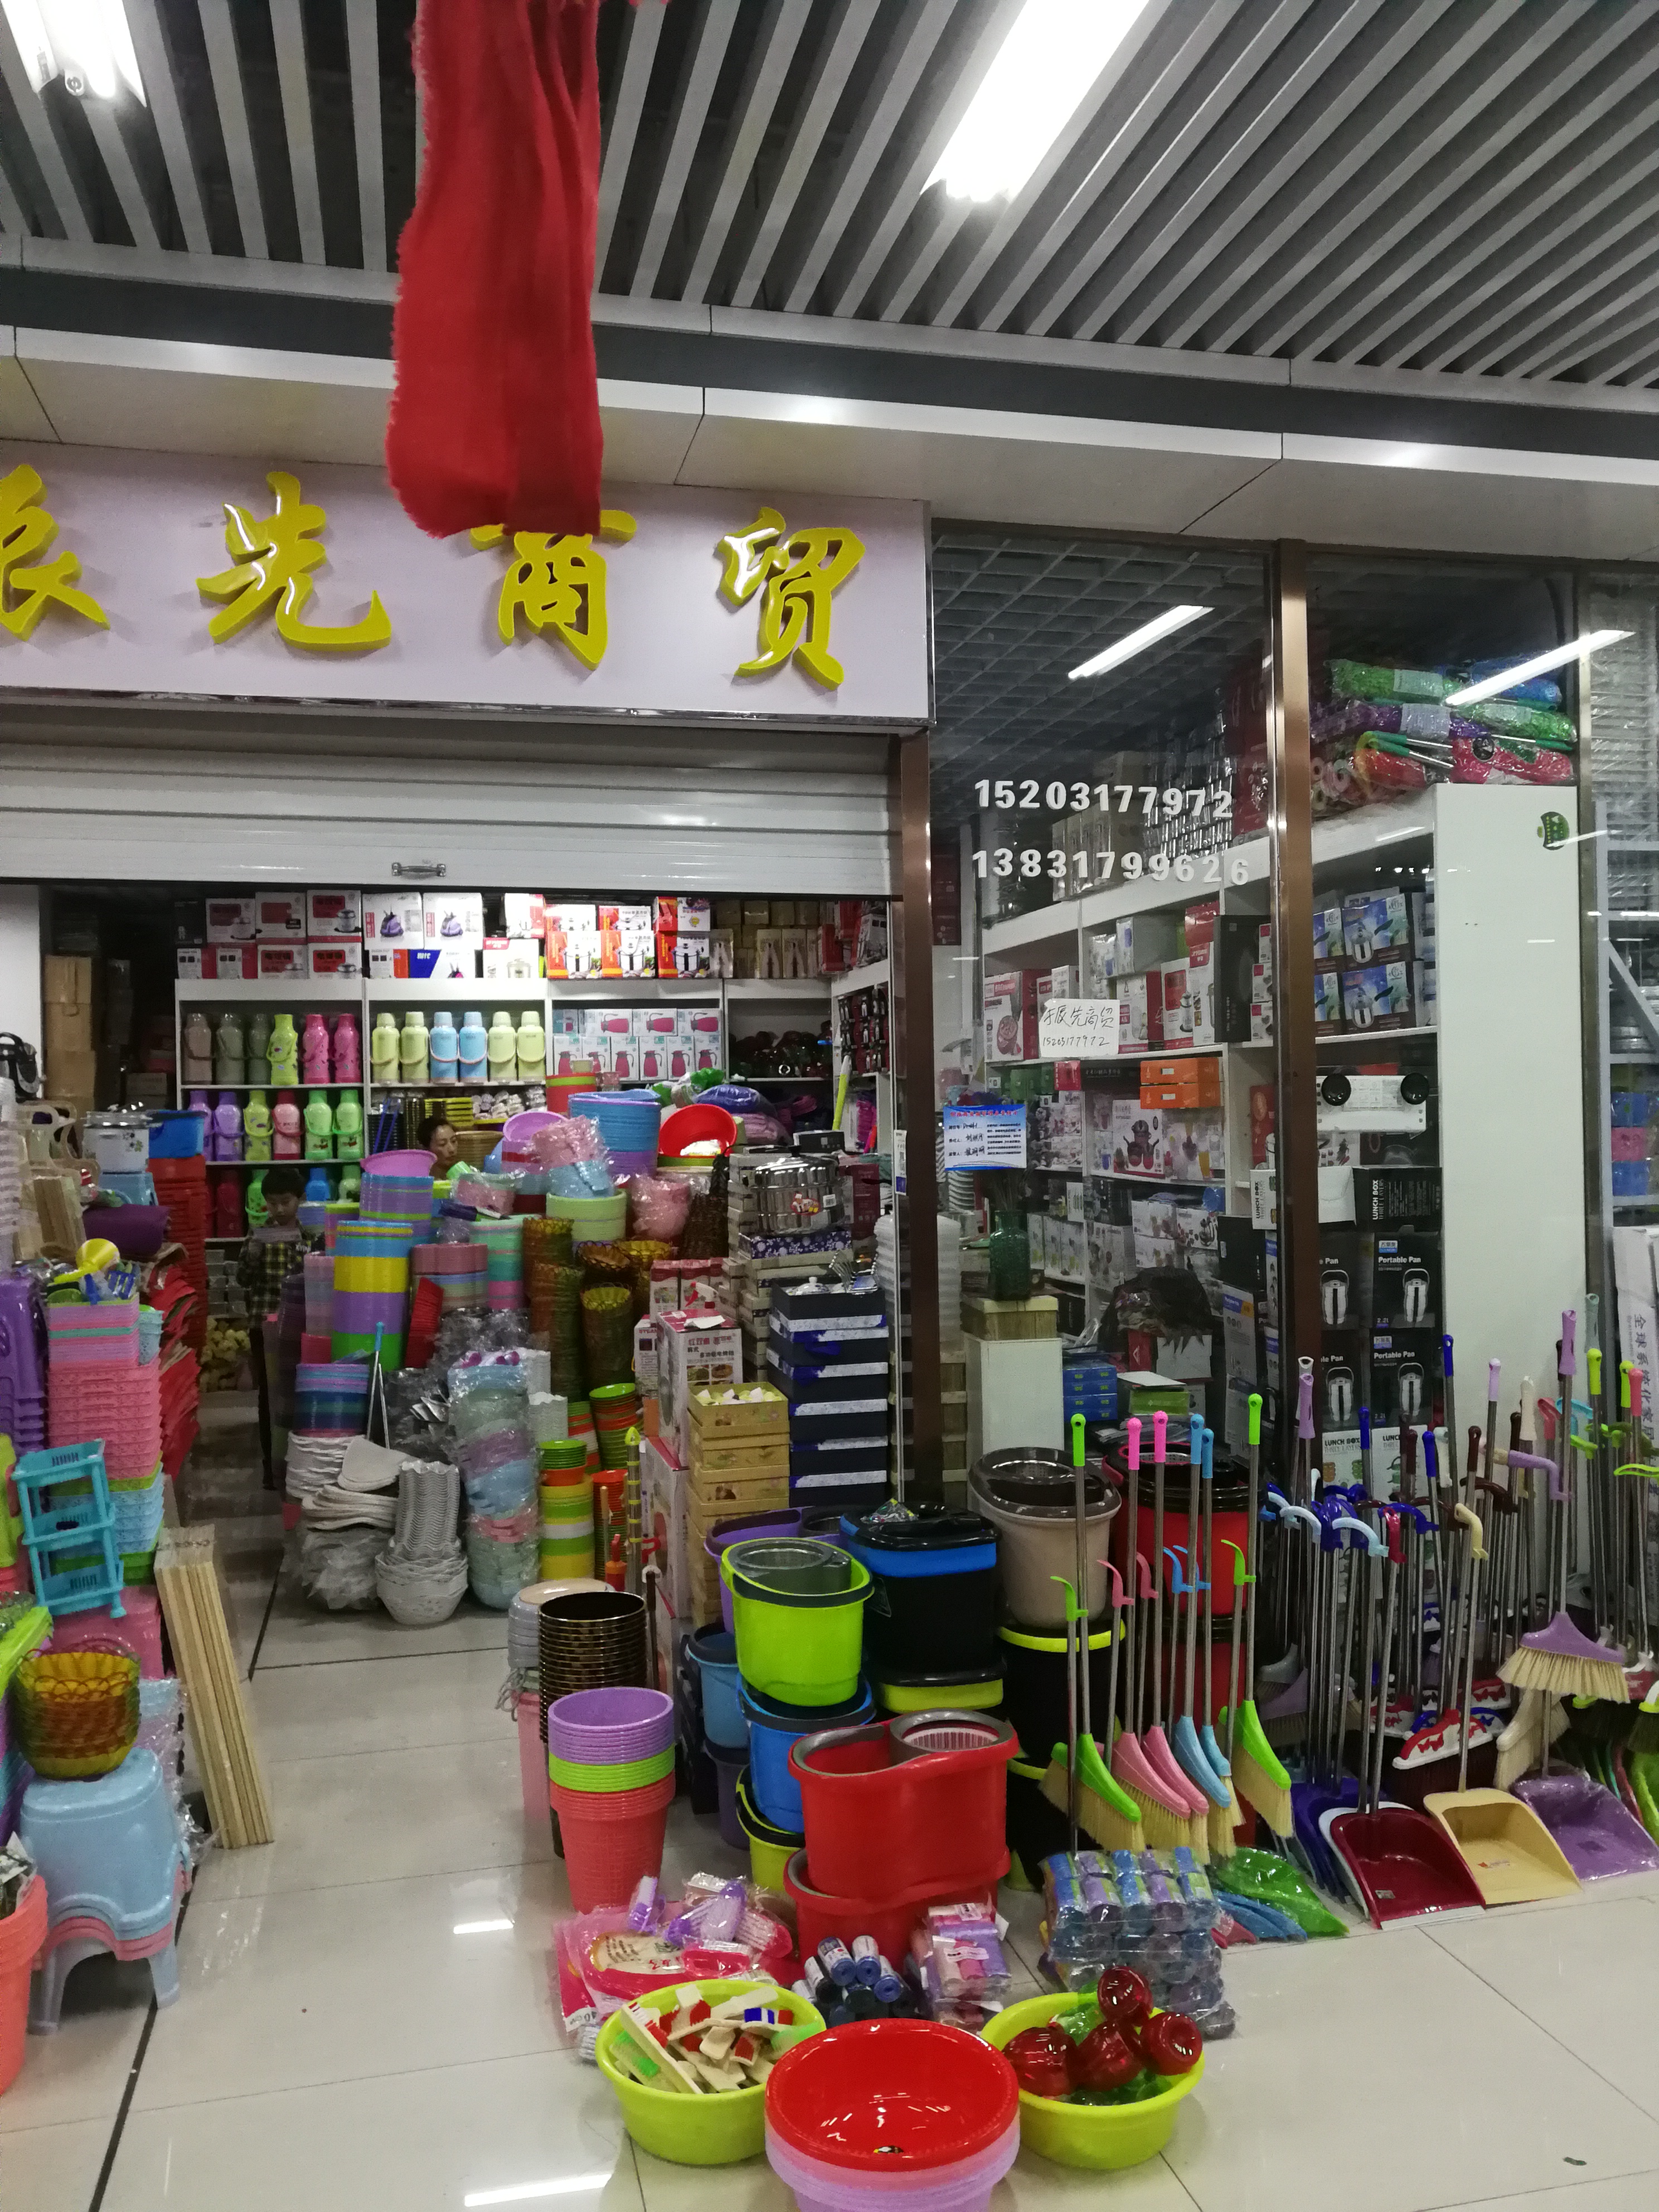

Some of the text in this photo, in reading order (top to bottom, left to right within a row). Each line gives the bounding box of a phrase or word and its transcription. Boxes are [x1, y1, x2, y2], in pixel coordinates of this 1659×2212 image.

[974, 779, 1233, 818] 15203177972
[972, 848, 1249, 886] 13831799626
[1043, 1035, 1110, 1047] 15203177972
